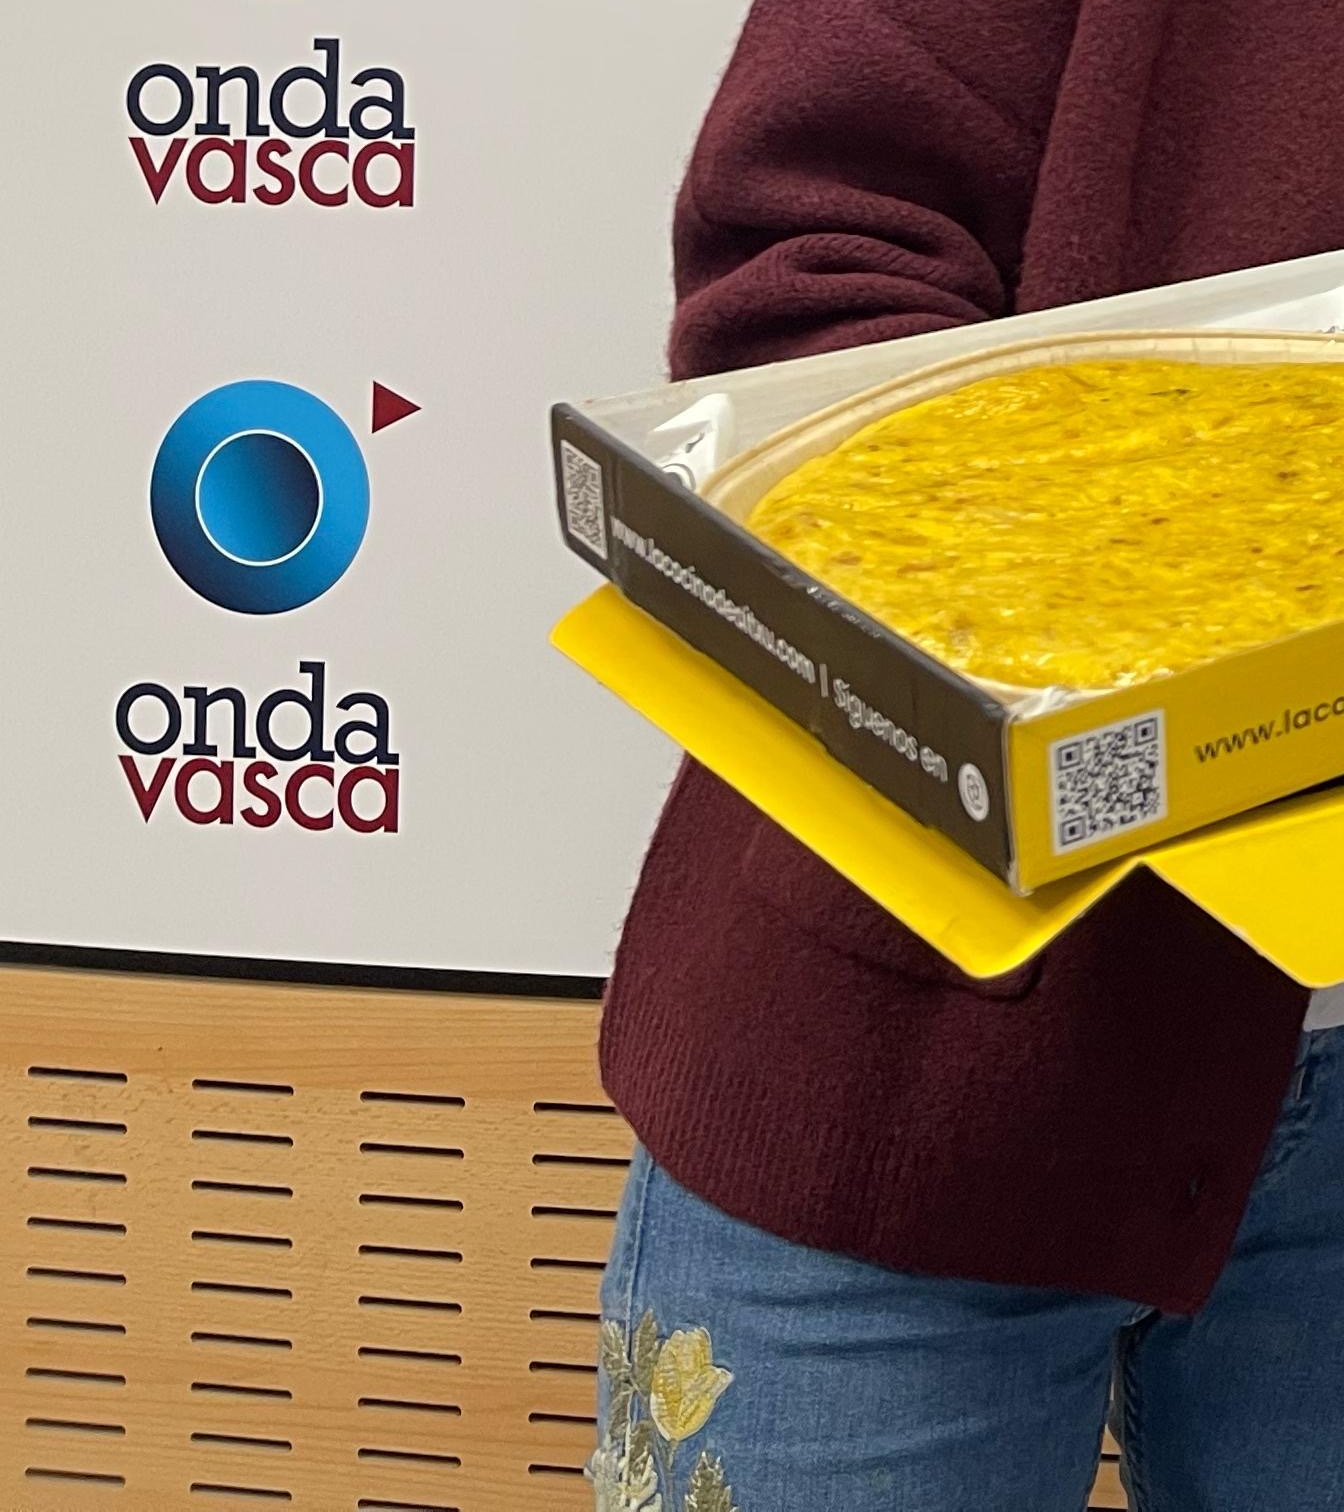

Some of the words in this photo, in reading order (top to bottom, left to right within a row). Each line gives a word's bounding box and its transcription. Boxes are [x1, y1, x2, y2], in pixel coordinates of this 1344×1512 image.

[127, 38, 415, 140] onda
[128, 136, 415, 208] vasca
[115, 661, 400, 766] onda
[117, 754, 400, 834] vasca
[919, 745, 949, 782] en
